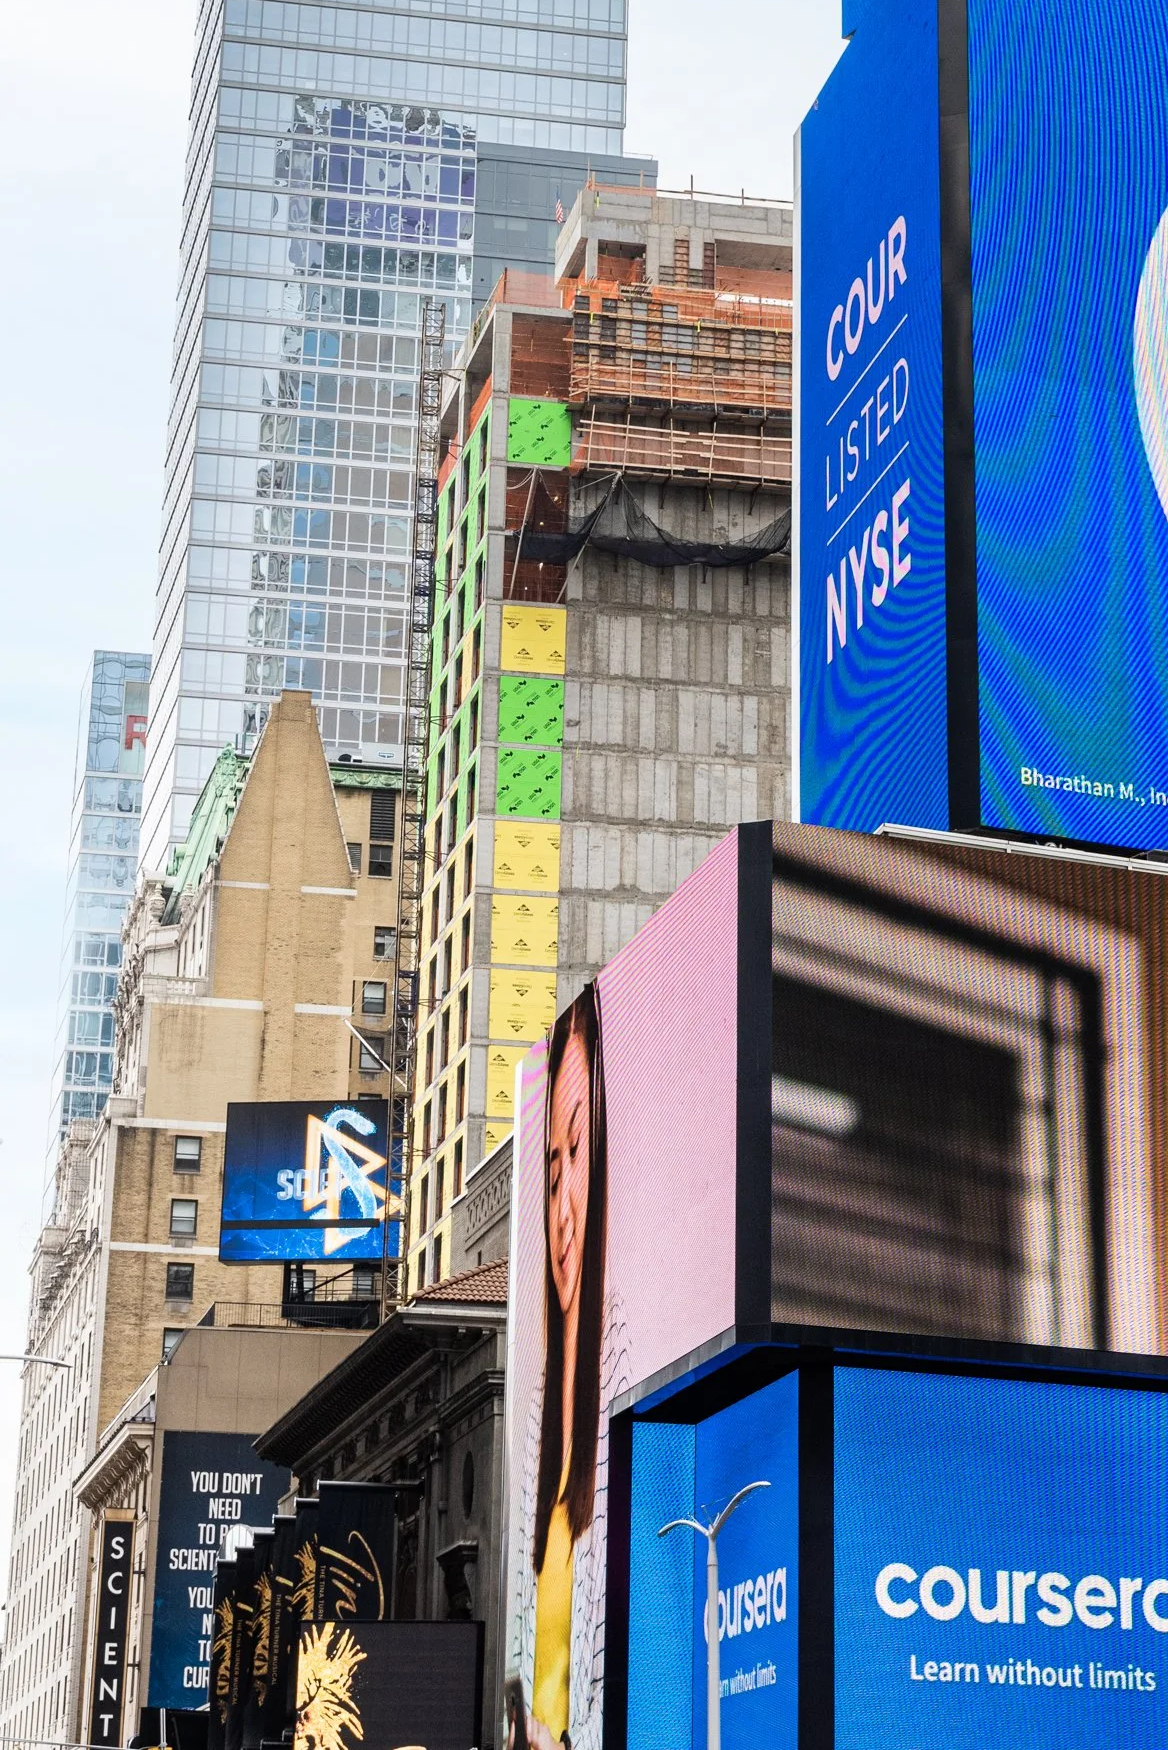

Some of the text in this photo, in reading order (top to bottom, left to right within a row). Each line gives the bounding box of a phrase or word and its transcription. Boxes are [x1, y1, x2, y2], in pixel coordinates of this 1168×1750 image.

[826, 214, 908, 382] COUR
[825, 357, 909, 512] LISTED
[826, 477, 912, 665] NYSE
[1020, 766, 1114, 799] Bharathan
[191, 1471, 263, 1495] YOU DON'T
[209, 1498, 242, 1520] NEED
[198, 1523, 216, 1545] TO
[169, 1548, 217, 1571] SCIENT
[910, 1654, 1157, 1693] Learn without limits
